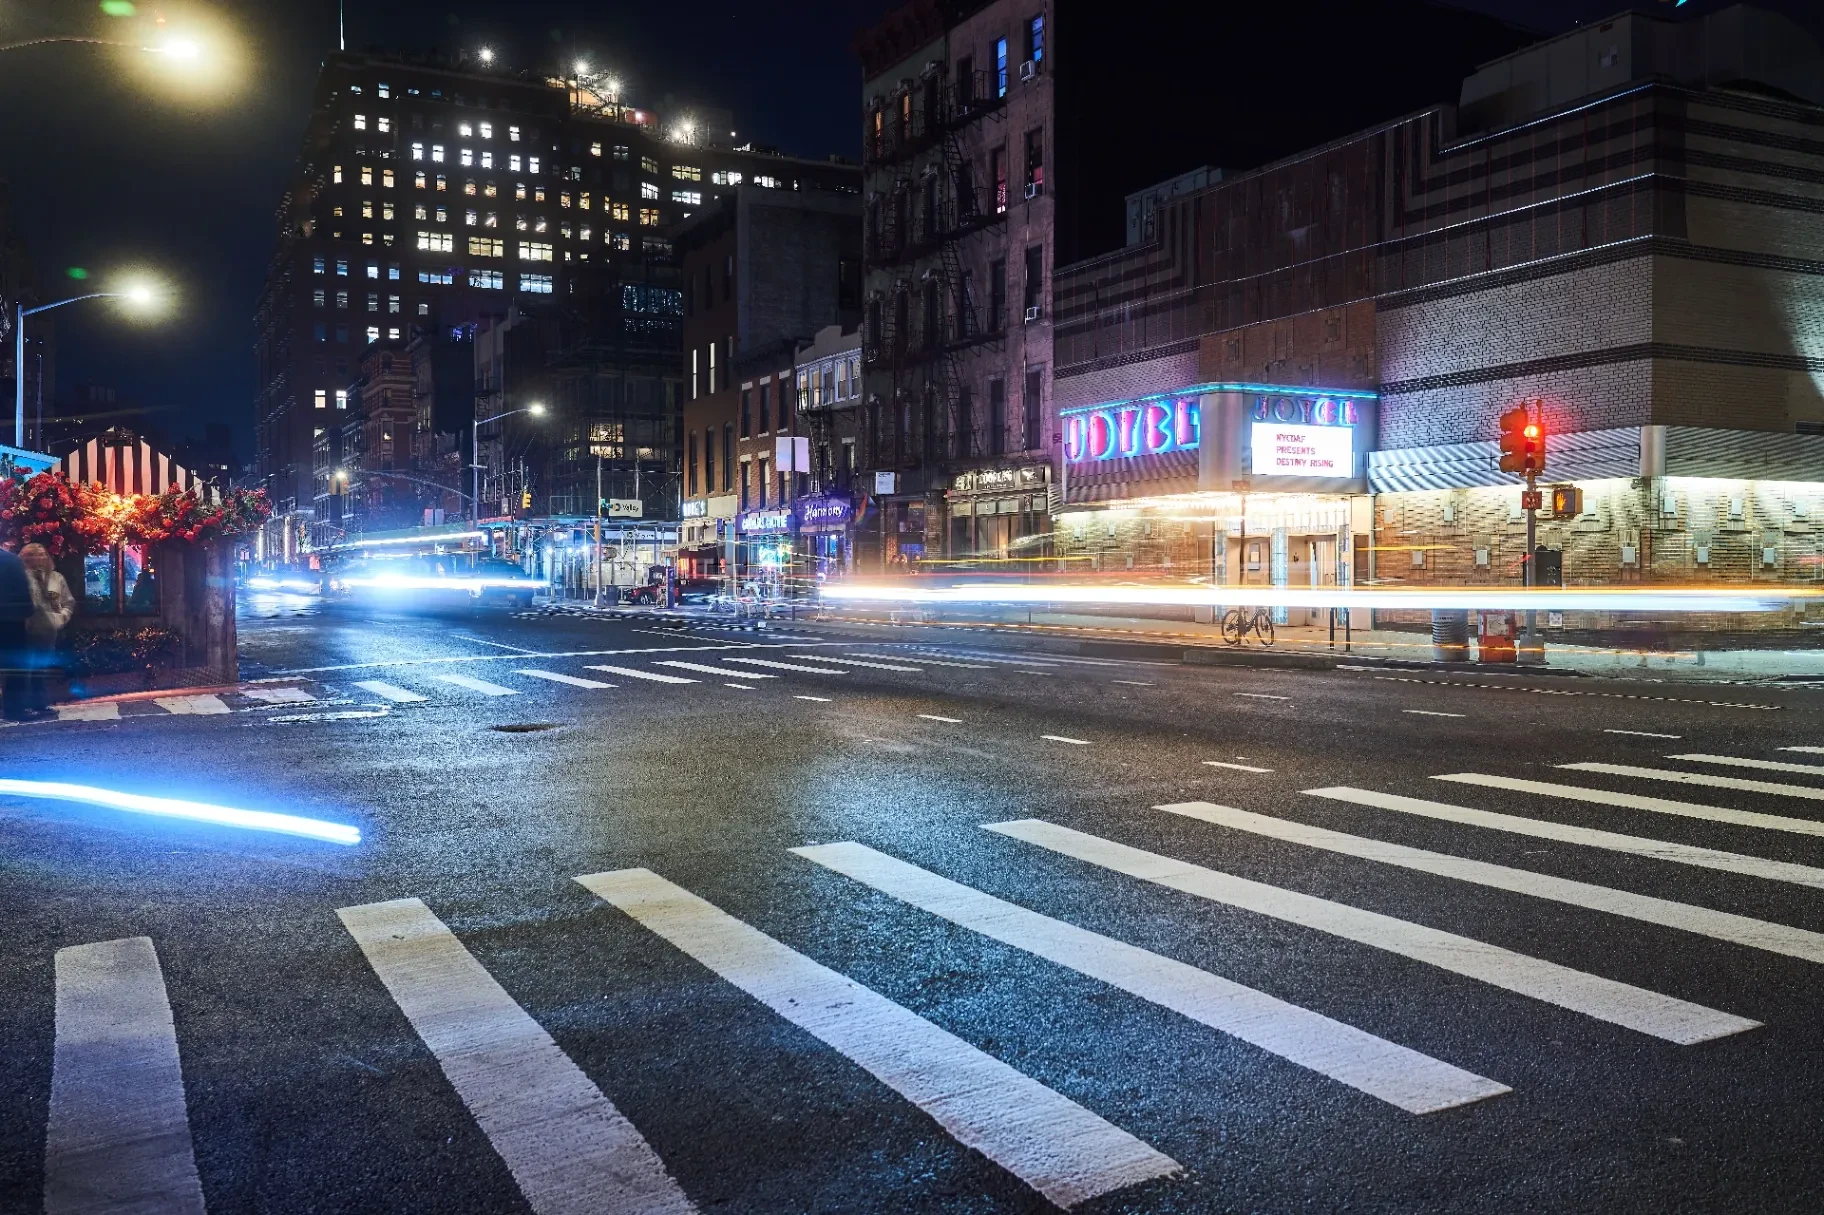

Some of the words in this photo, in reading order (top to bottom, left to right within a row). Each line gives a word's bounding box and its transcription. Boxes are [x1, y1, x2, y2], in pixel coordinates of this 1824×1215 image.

[1251, 396, 1358, 425] JOYCE
[1064, 401, 1199, 461] JOYCE
[1276, 446, 1316, 455] PRESENTS
[1276, 458, 1307, 467] DESTINY
[1310, 459, 1334, 468] RISING
[804, 504, 844, 521] Harmony
